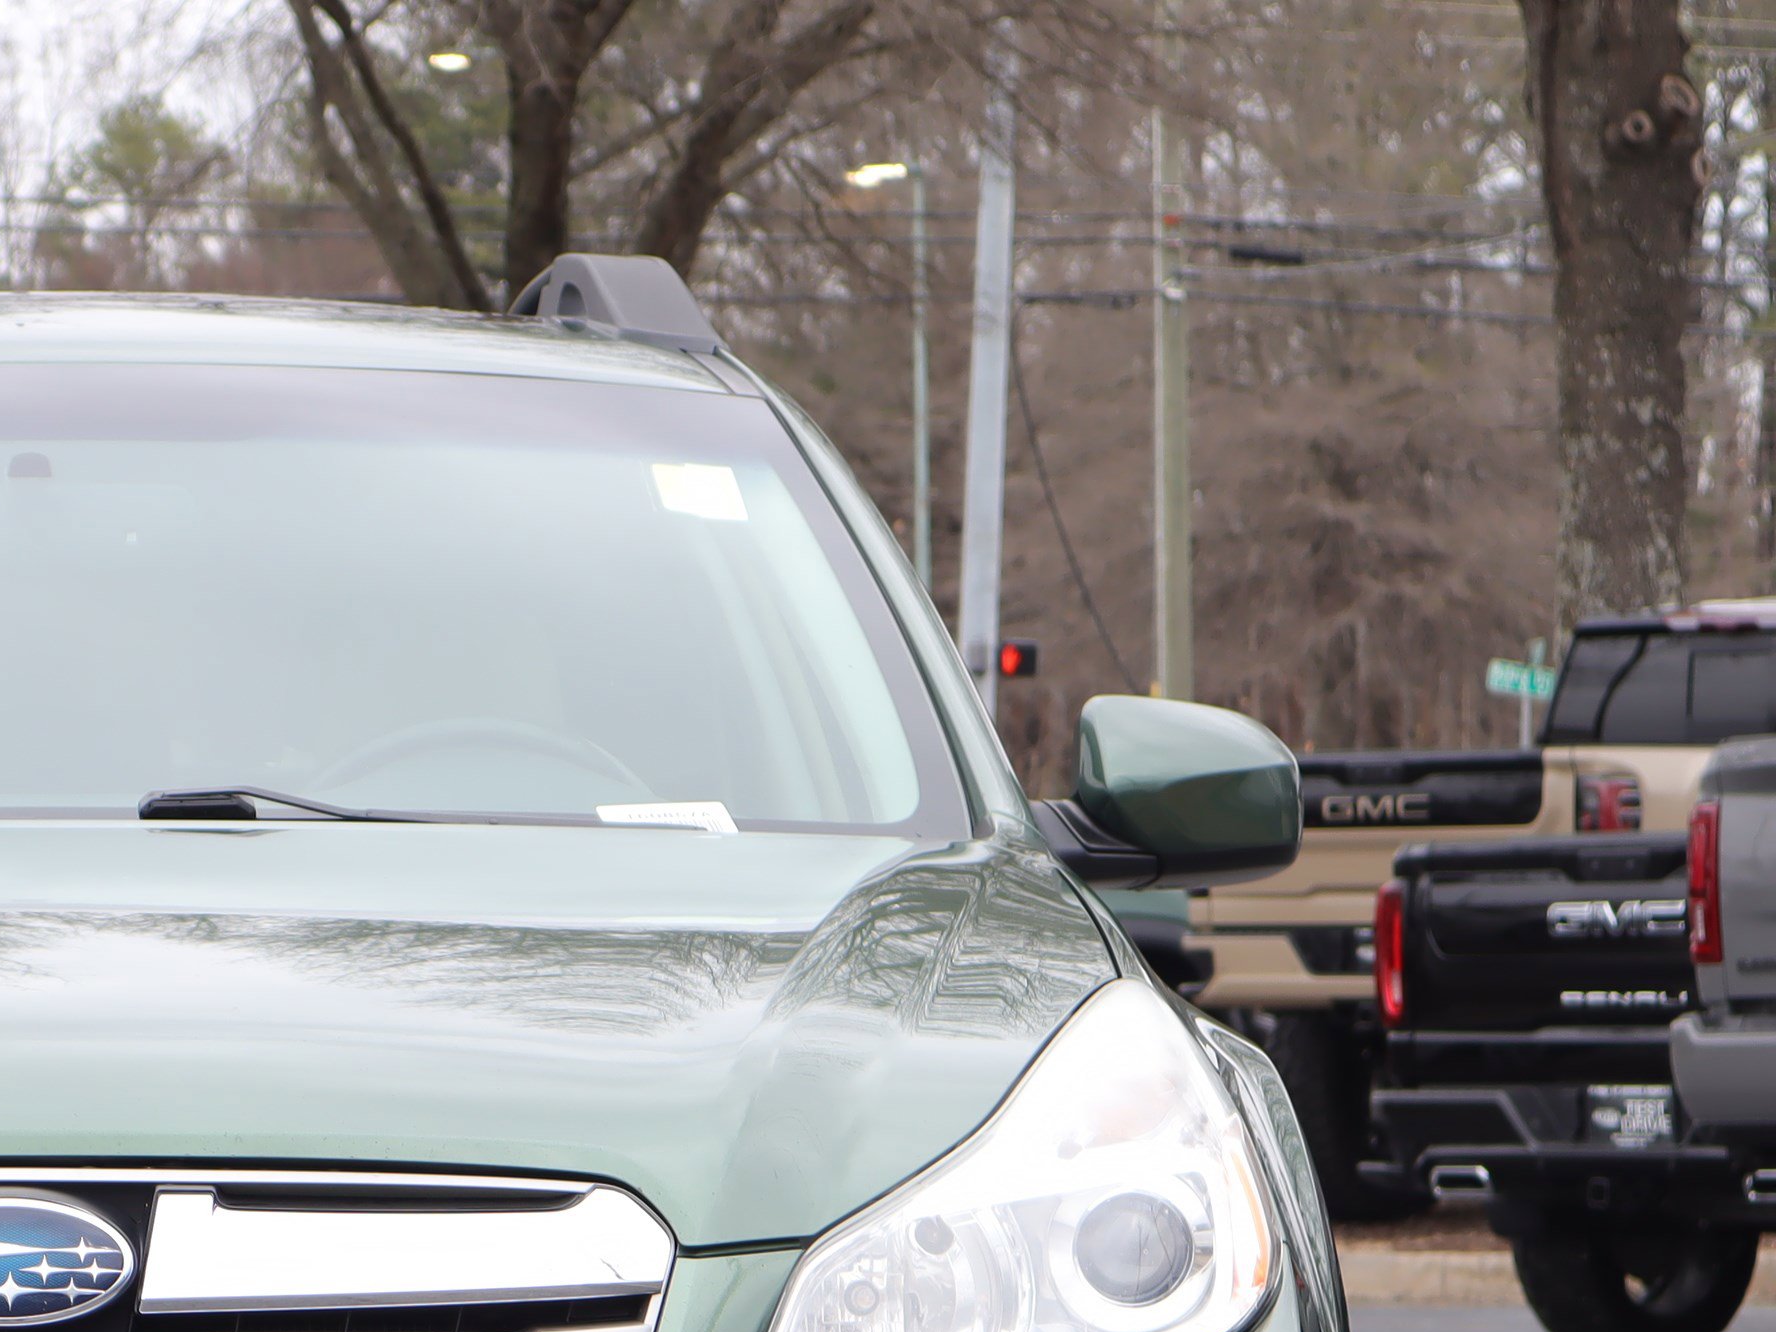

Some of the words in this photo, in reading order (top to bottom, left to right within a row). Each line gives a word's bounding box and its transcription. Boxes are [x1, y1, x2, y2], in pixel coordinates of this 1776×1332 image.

[1322, 793, 1430, 821] GMC
[1546, 900, 1687, 937] GMC
[1560, 990, 1689, 1006] DENALI
